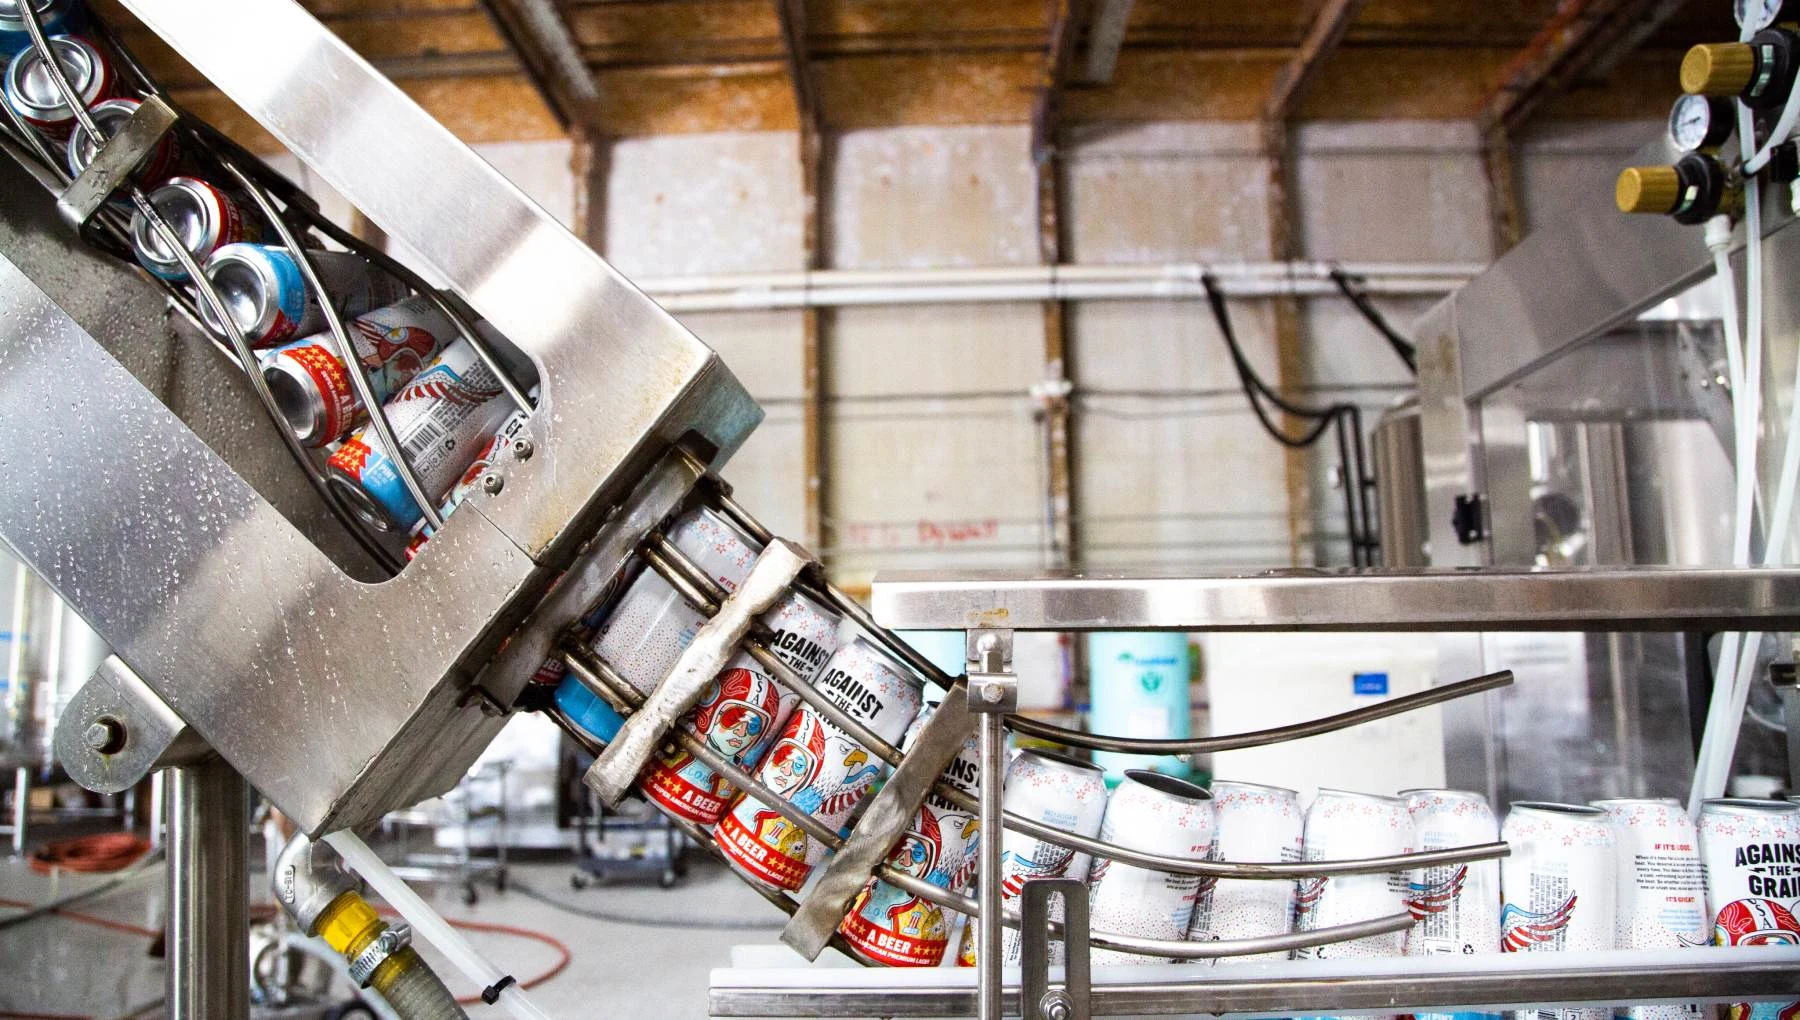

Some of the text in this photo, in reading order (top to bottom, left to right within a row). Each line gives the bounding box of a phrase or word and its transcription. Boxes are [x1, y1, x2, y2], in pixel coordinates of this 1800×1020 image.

[788, 655, 807, 672] THE
[821, 668, 884, 720] AGAINST
[833, 694, 852, 713] THE
[681, 789, 722, 814] A BEER
[729, 827, 741, 840] A
[737, 833, 768, 862] BEER
[1767, 865, 1792, 876] THE
[866, 929, 912, 955] A BEER
